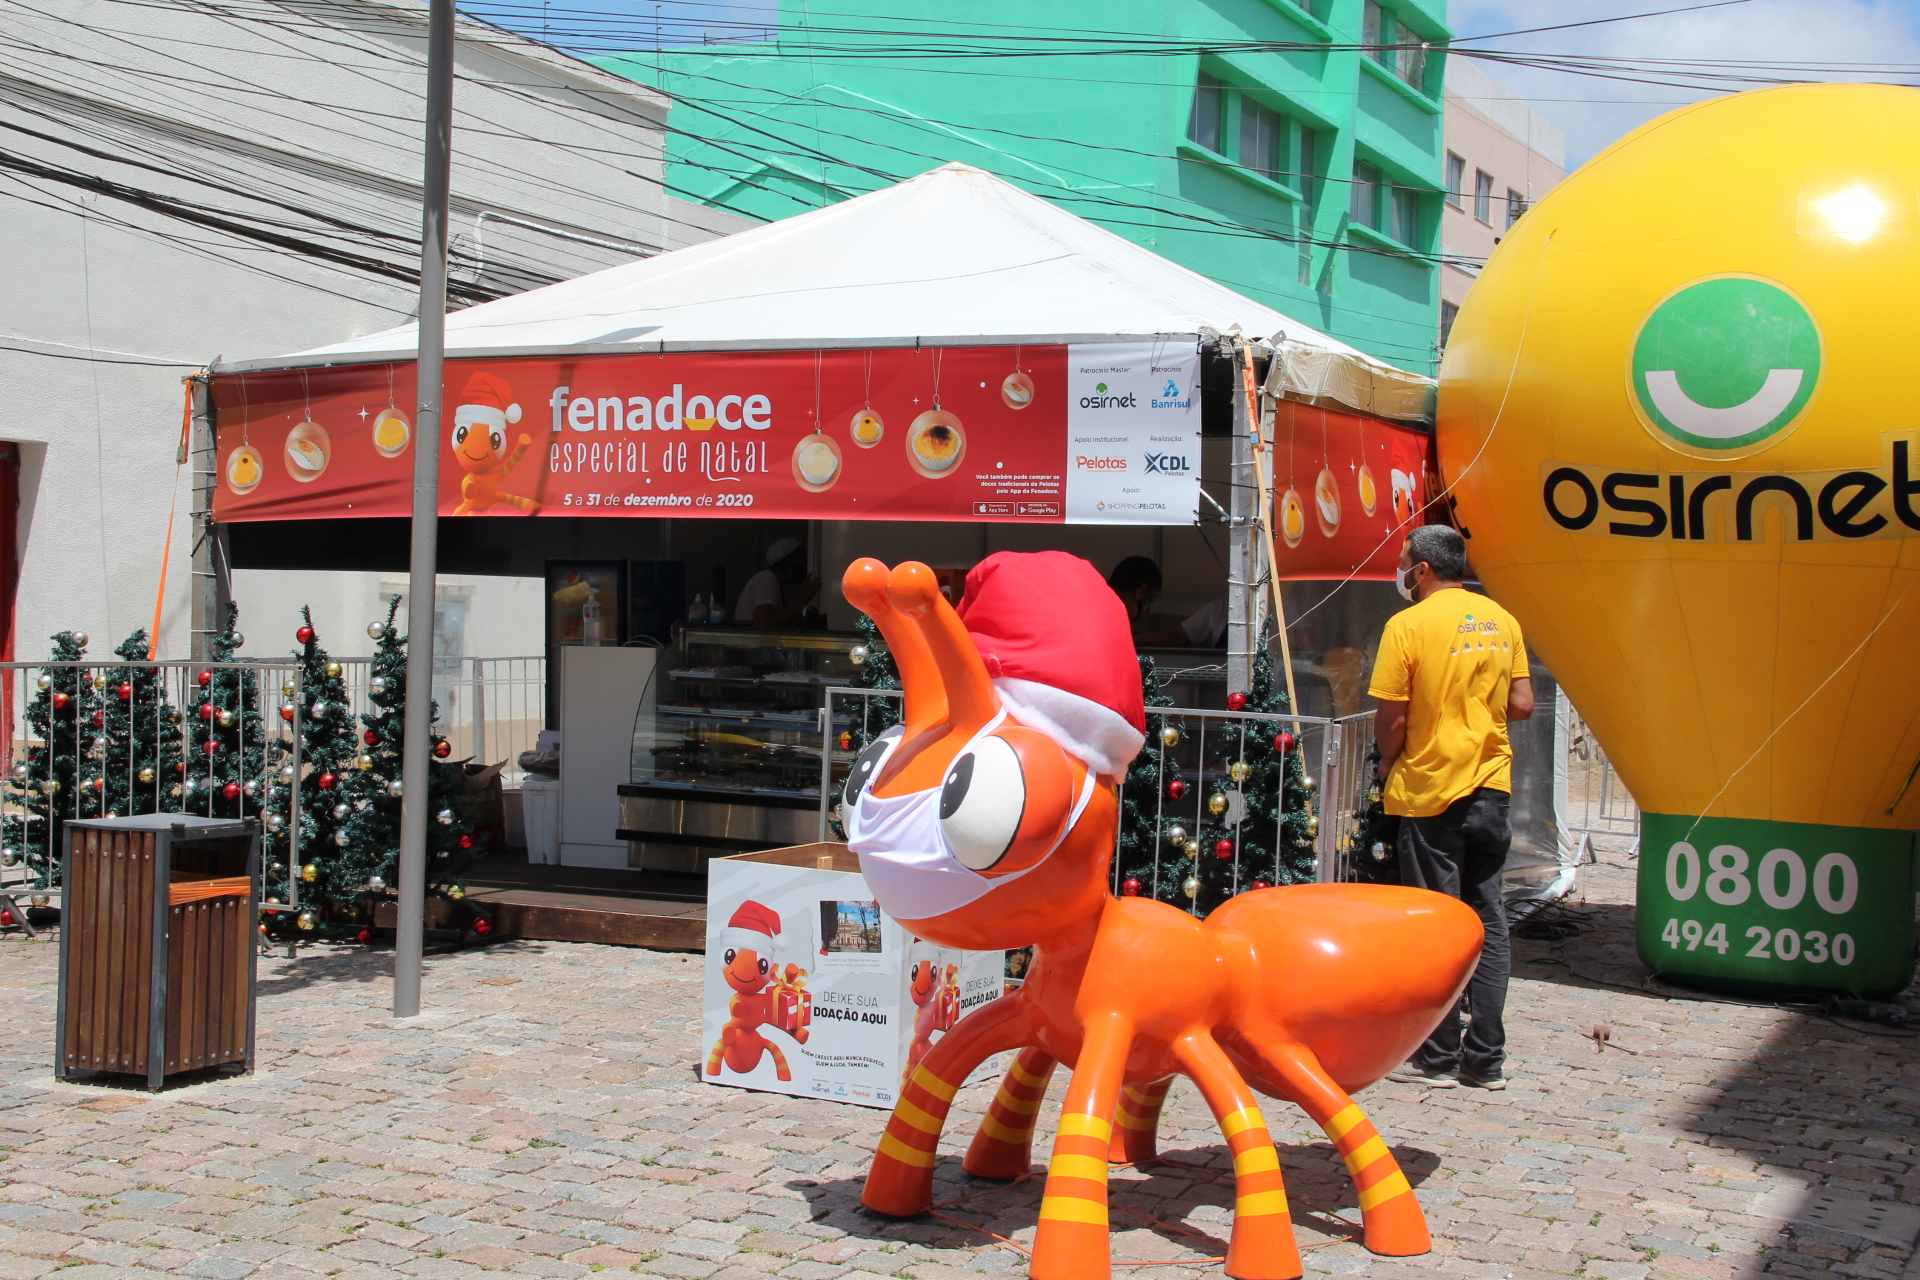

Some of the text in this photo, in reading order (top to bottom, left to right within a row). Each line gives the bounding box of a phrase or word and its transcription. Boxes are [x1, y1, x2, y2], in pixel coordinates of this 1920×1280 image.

[550, 384, 771, 431] fenadoce
[1080, 392, 1136, 408] osirnet
[1152, 398, 1190, 408] Banrisul
[550, 442, 650, 473] especial
[662, 442, 687, 473] de
[1076, 456, 1127, 469] Pelotas
[1544, 440, 1920, 541] osirnet
[563, 493, 754, 507] 5 a 31 de dezembro de 2020
[1665, 840, 1859, 915] 0800
[1661, 918, 1855, 966] 494 2030
[966, 976, 994, 992] DEIXE SUA
[824, 991, 878, 1008] DEIXE SUA
[961, 989, 998, 1009] DOAÇÃO AQUI
[814, 1007, 886, 1025] DOAÇÃO AQUI
[801, 1048, 814, 1057] QUEM
